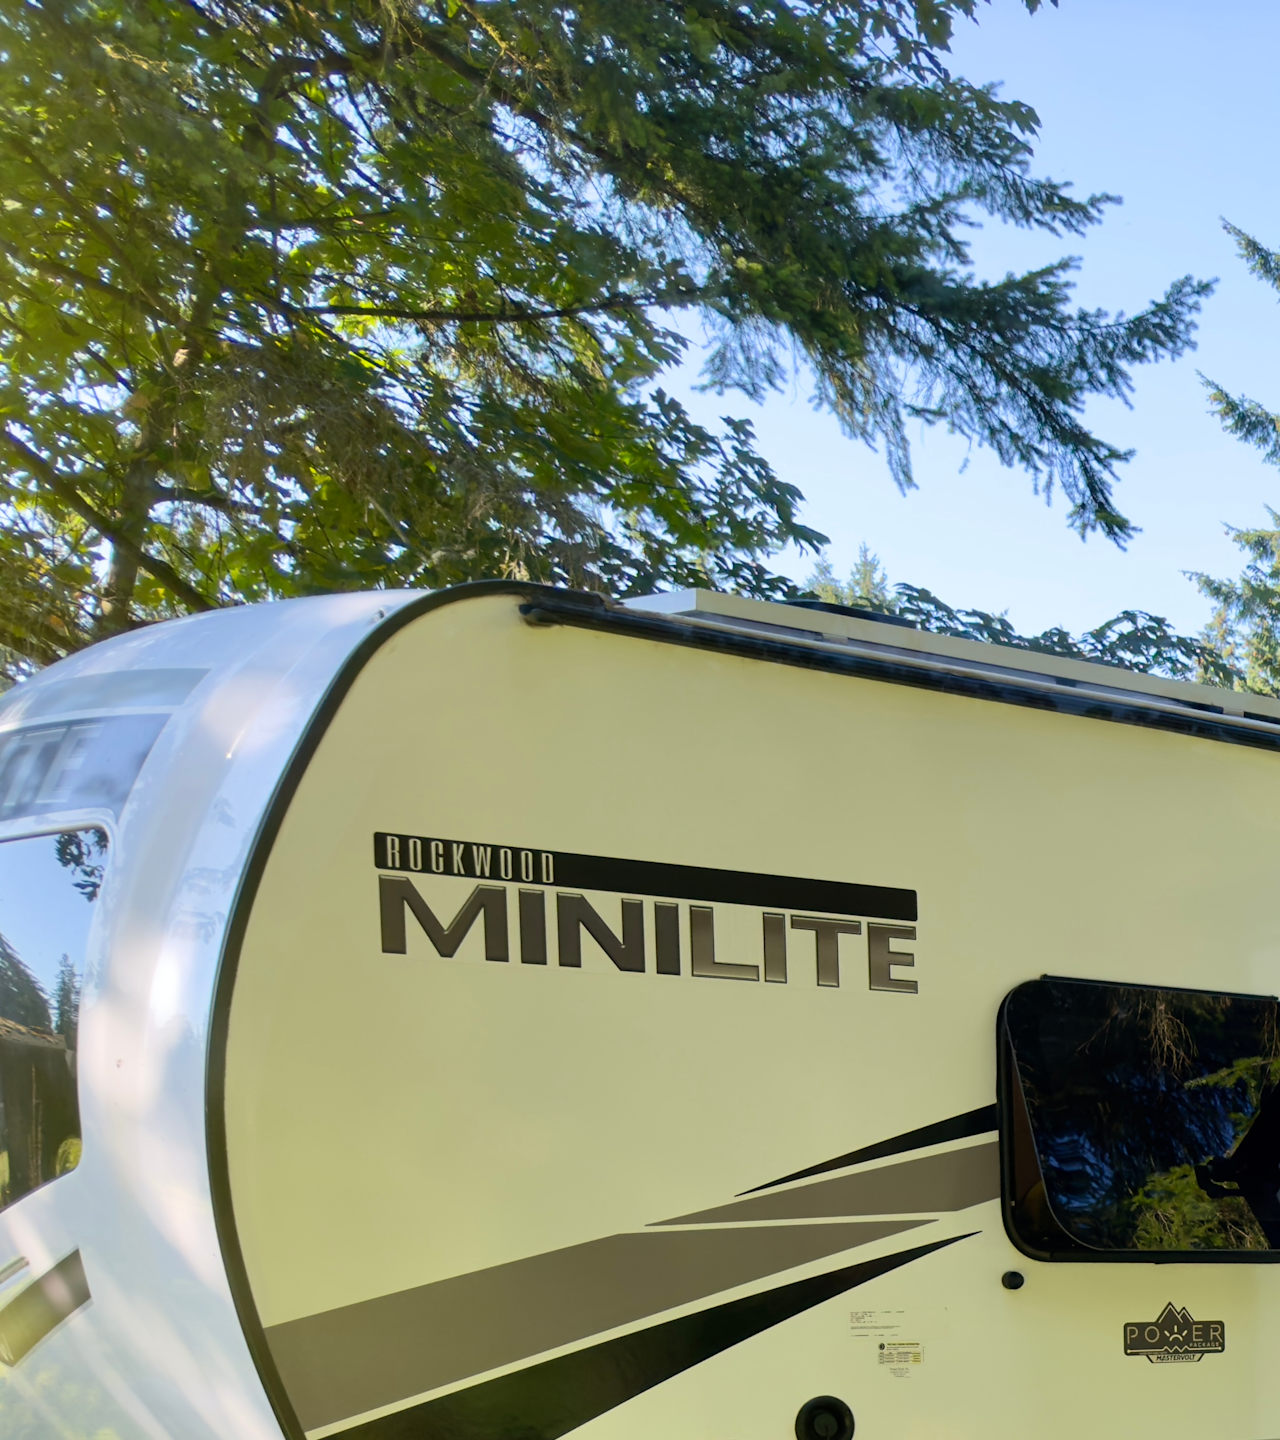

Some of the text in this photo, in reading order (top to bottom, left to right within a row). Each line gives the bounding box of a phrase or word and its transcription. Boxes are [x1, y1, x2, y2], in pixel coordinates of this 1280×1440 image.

[386, 835, 555, 884] ROCKWOOD
[378, 874, 918, 994] MINILITE
[1155, 1354, 1196, 1362] MASTERVOLT
